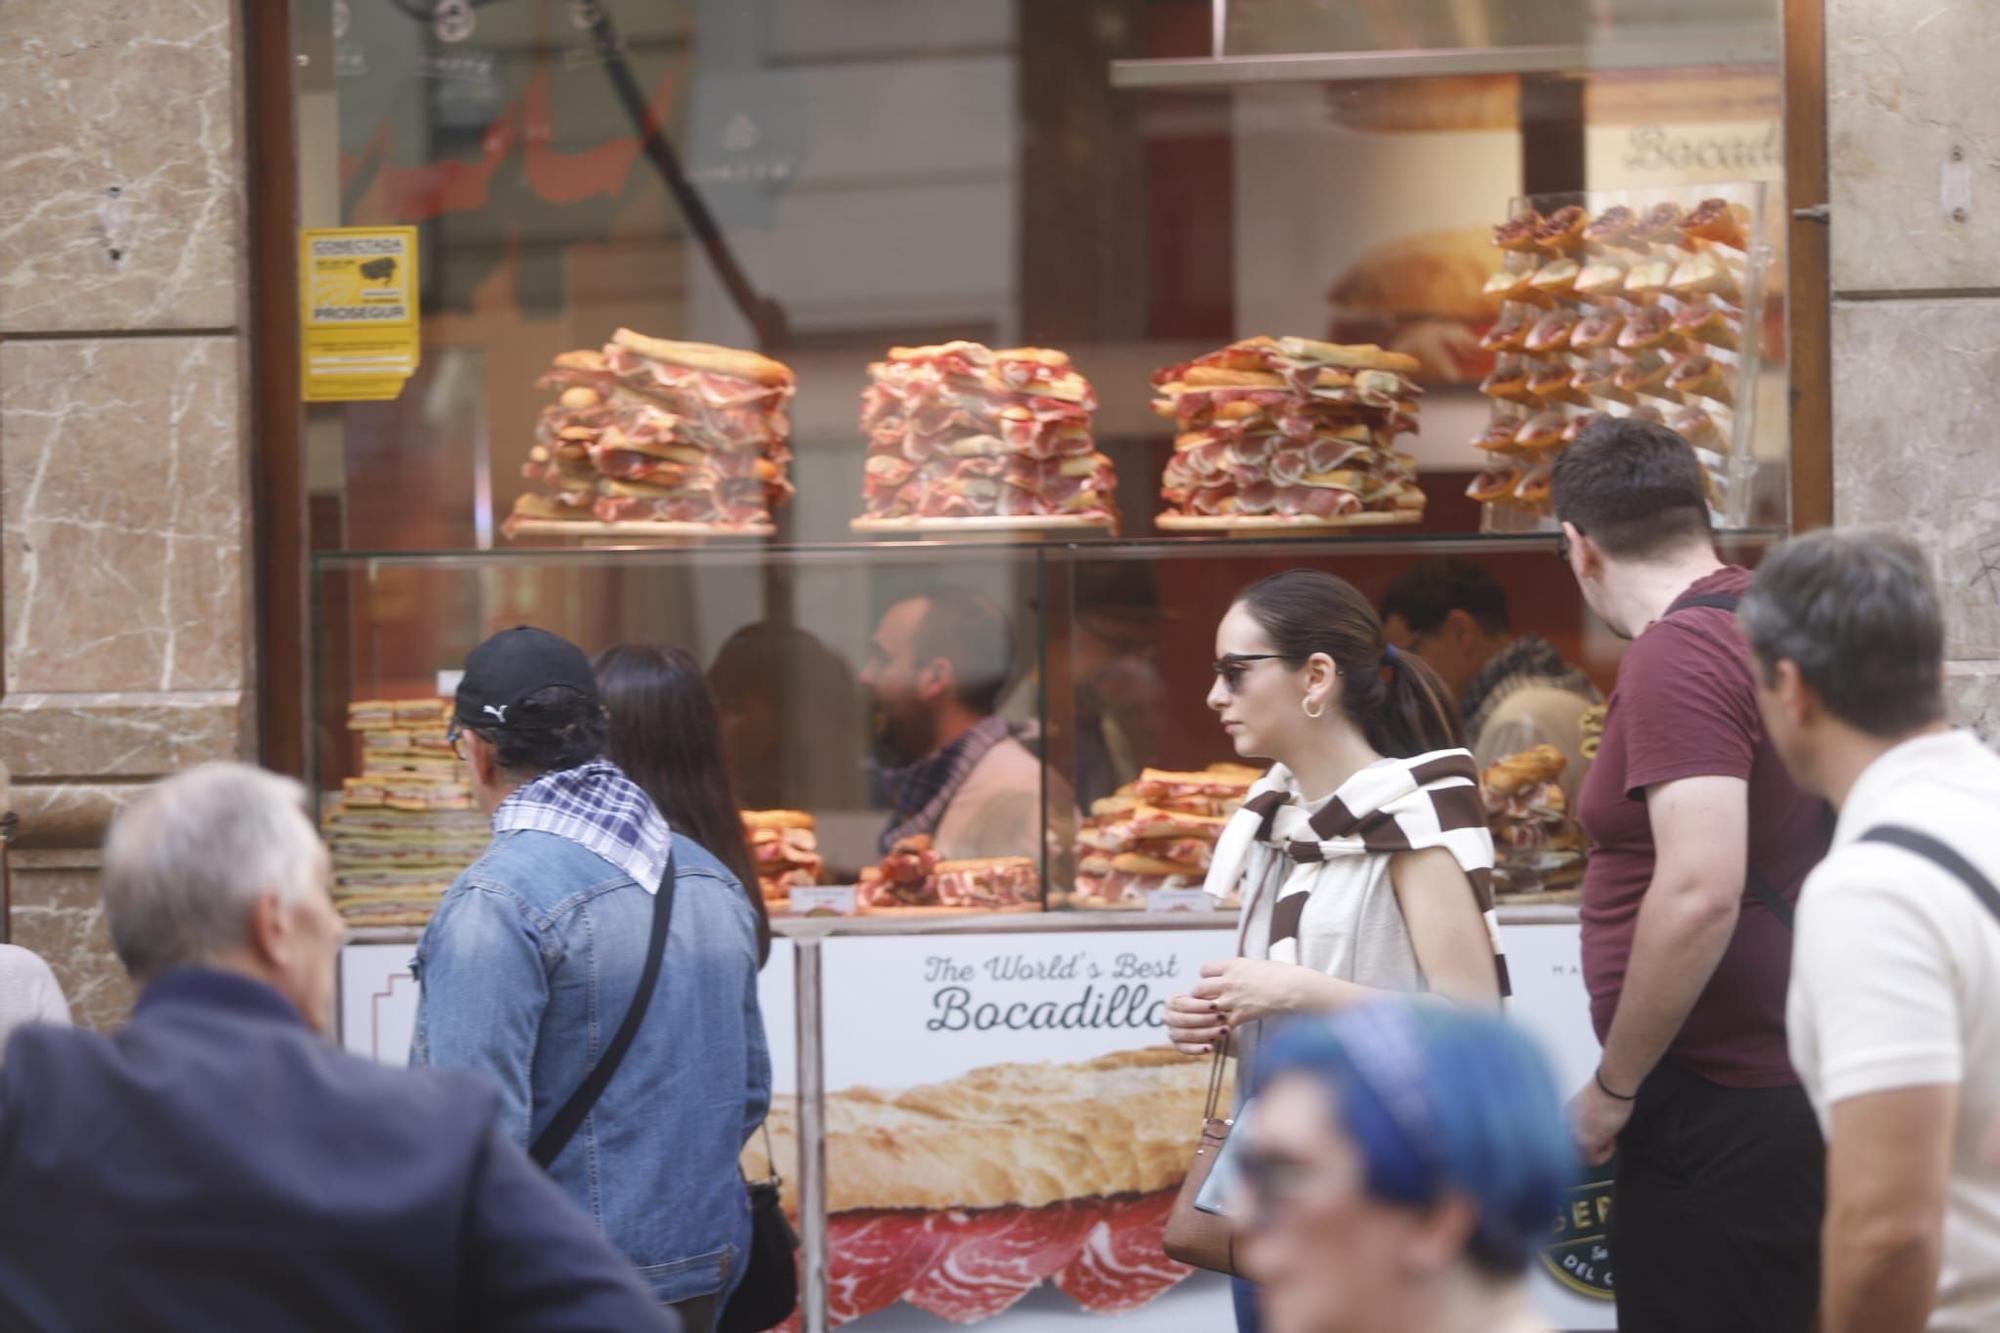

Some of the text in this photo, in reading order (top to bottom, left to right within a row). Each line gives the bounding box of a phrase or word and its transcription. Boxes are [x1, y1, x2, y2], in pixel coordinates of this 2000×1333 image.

[314, 306, 404, 320] PROSEGUR
[924, 952, 1179, 982] The World's Best
